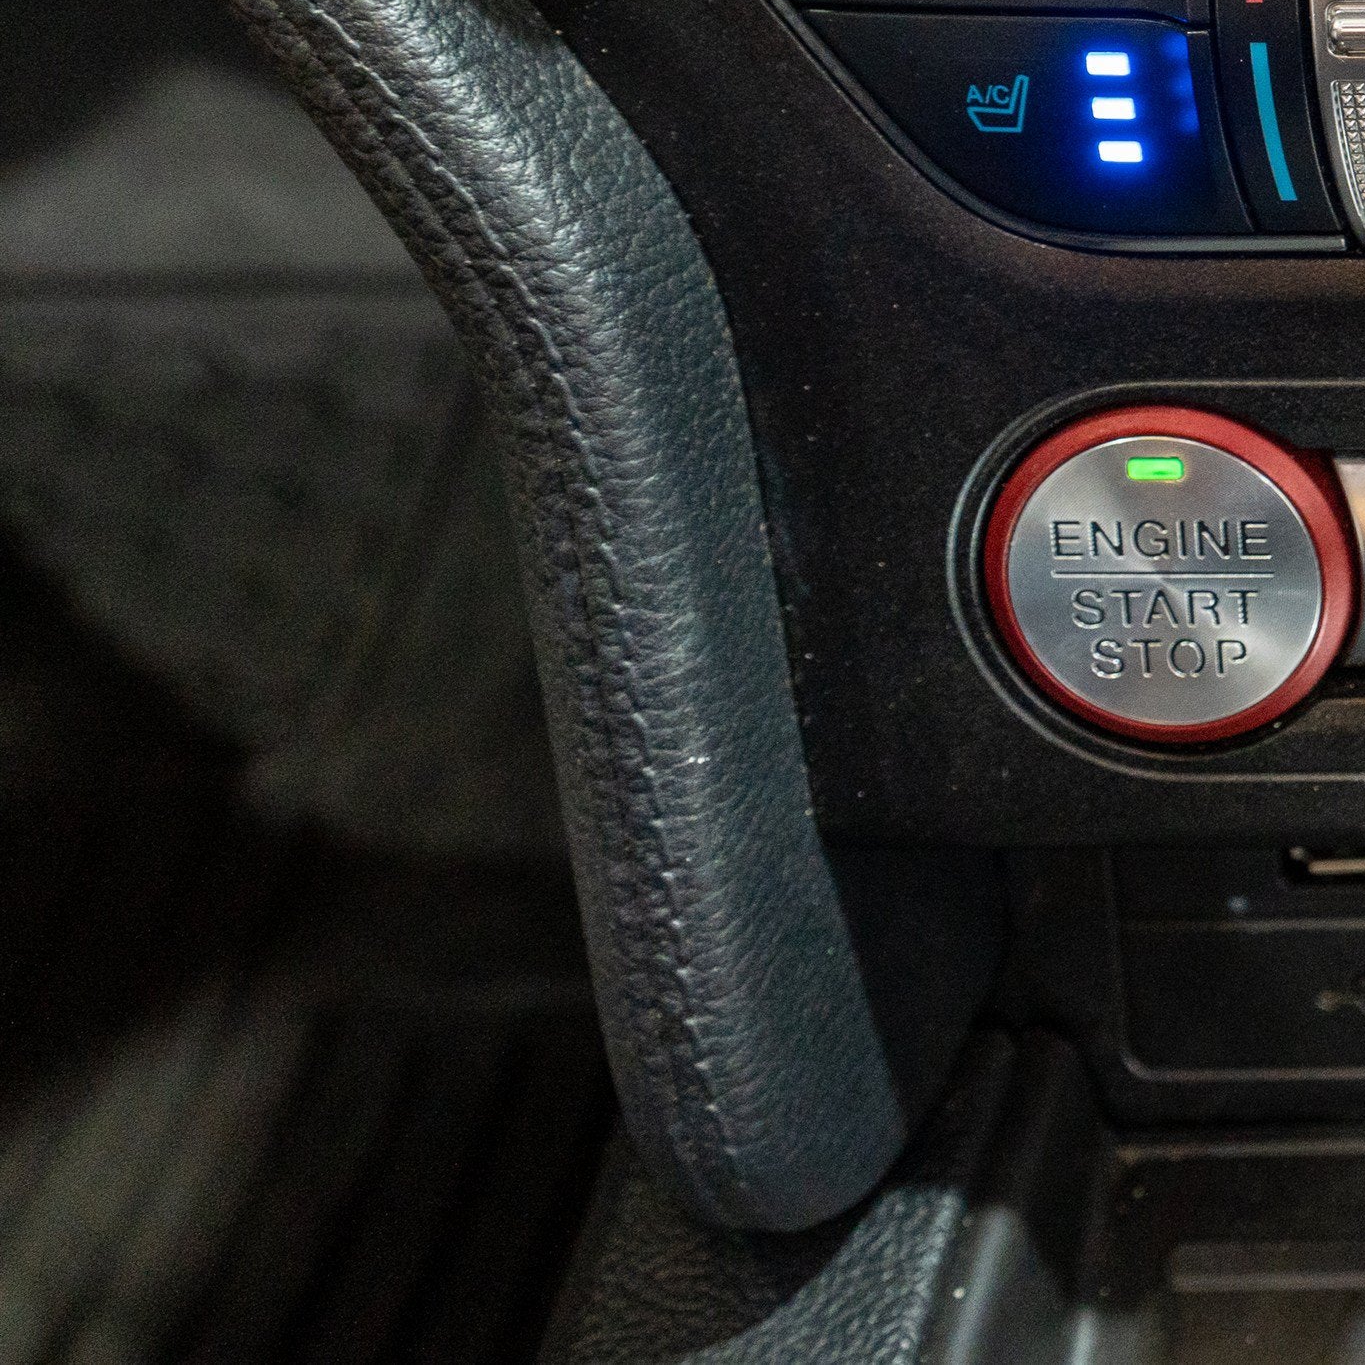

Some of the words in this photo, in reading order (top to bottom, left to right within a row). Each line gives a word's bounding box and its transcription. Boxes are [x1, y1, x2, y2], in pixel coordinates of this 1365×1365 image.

[965, 83, 1012, 106] A/C
[1050, 520, 1274, 560] ENGINE
[1071, 589, 1259, 629] START
[1089, 638, 1249, 679] STOP
